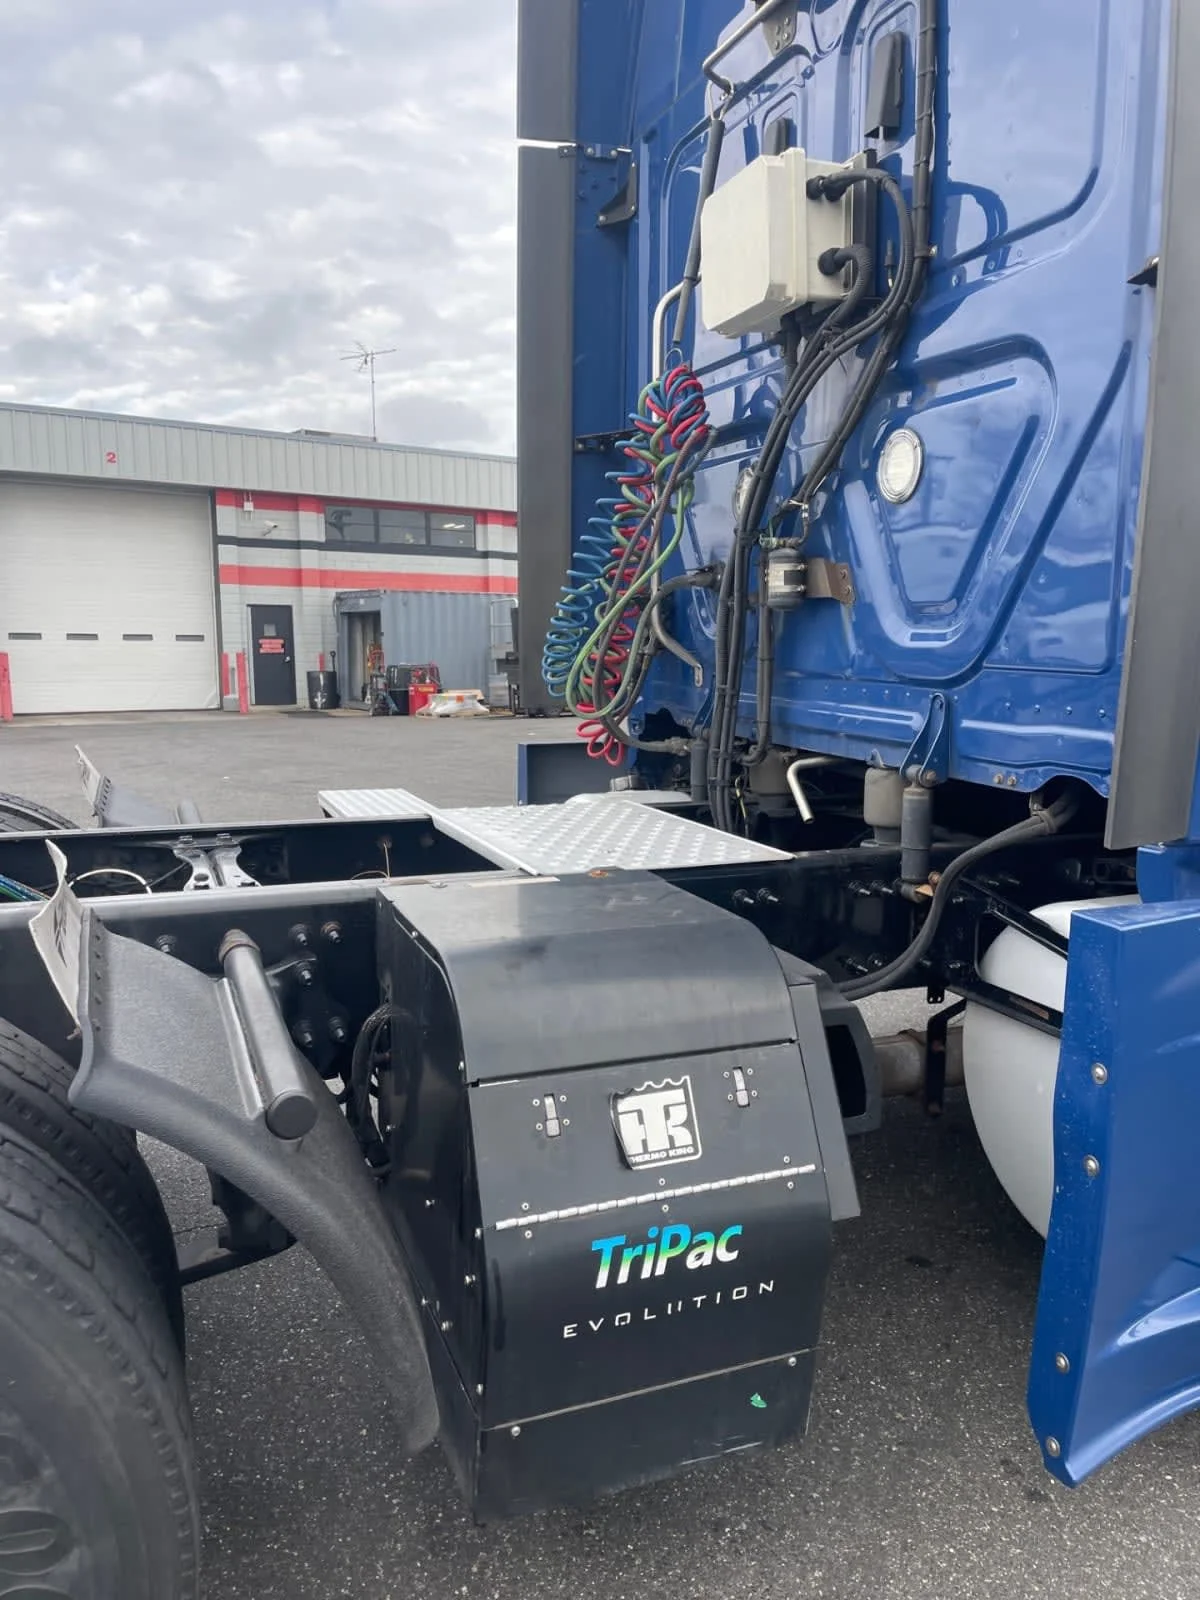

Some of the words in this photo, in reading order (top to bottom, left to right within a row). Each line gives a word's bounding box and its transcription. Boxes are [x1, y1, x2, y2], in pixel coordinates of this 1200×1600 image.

[106, 451, 117, 464] 2
[668, 1146, 694, 1157] KING
[591, 1223, 743, 1289] TriPac
